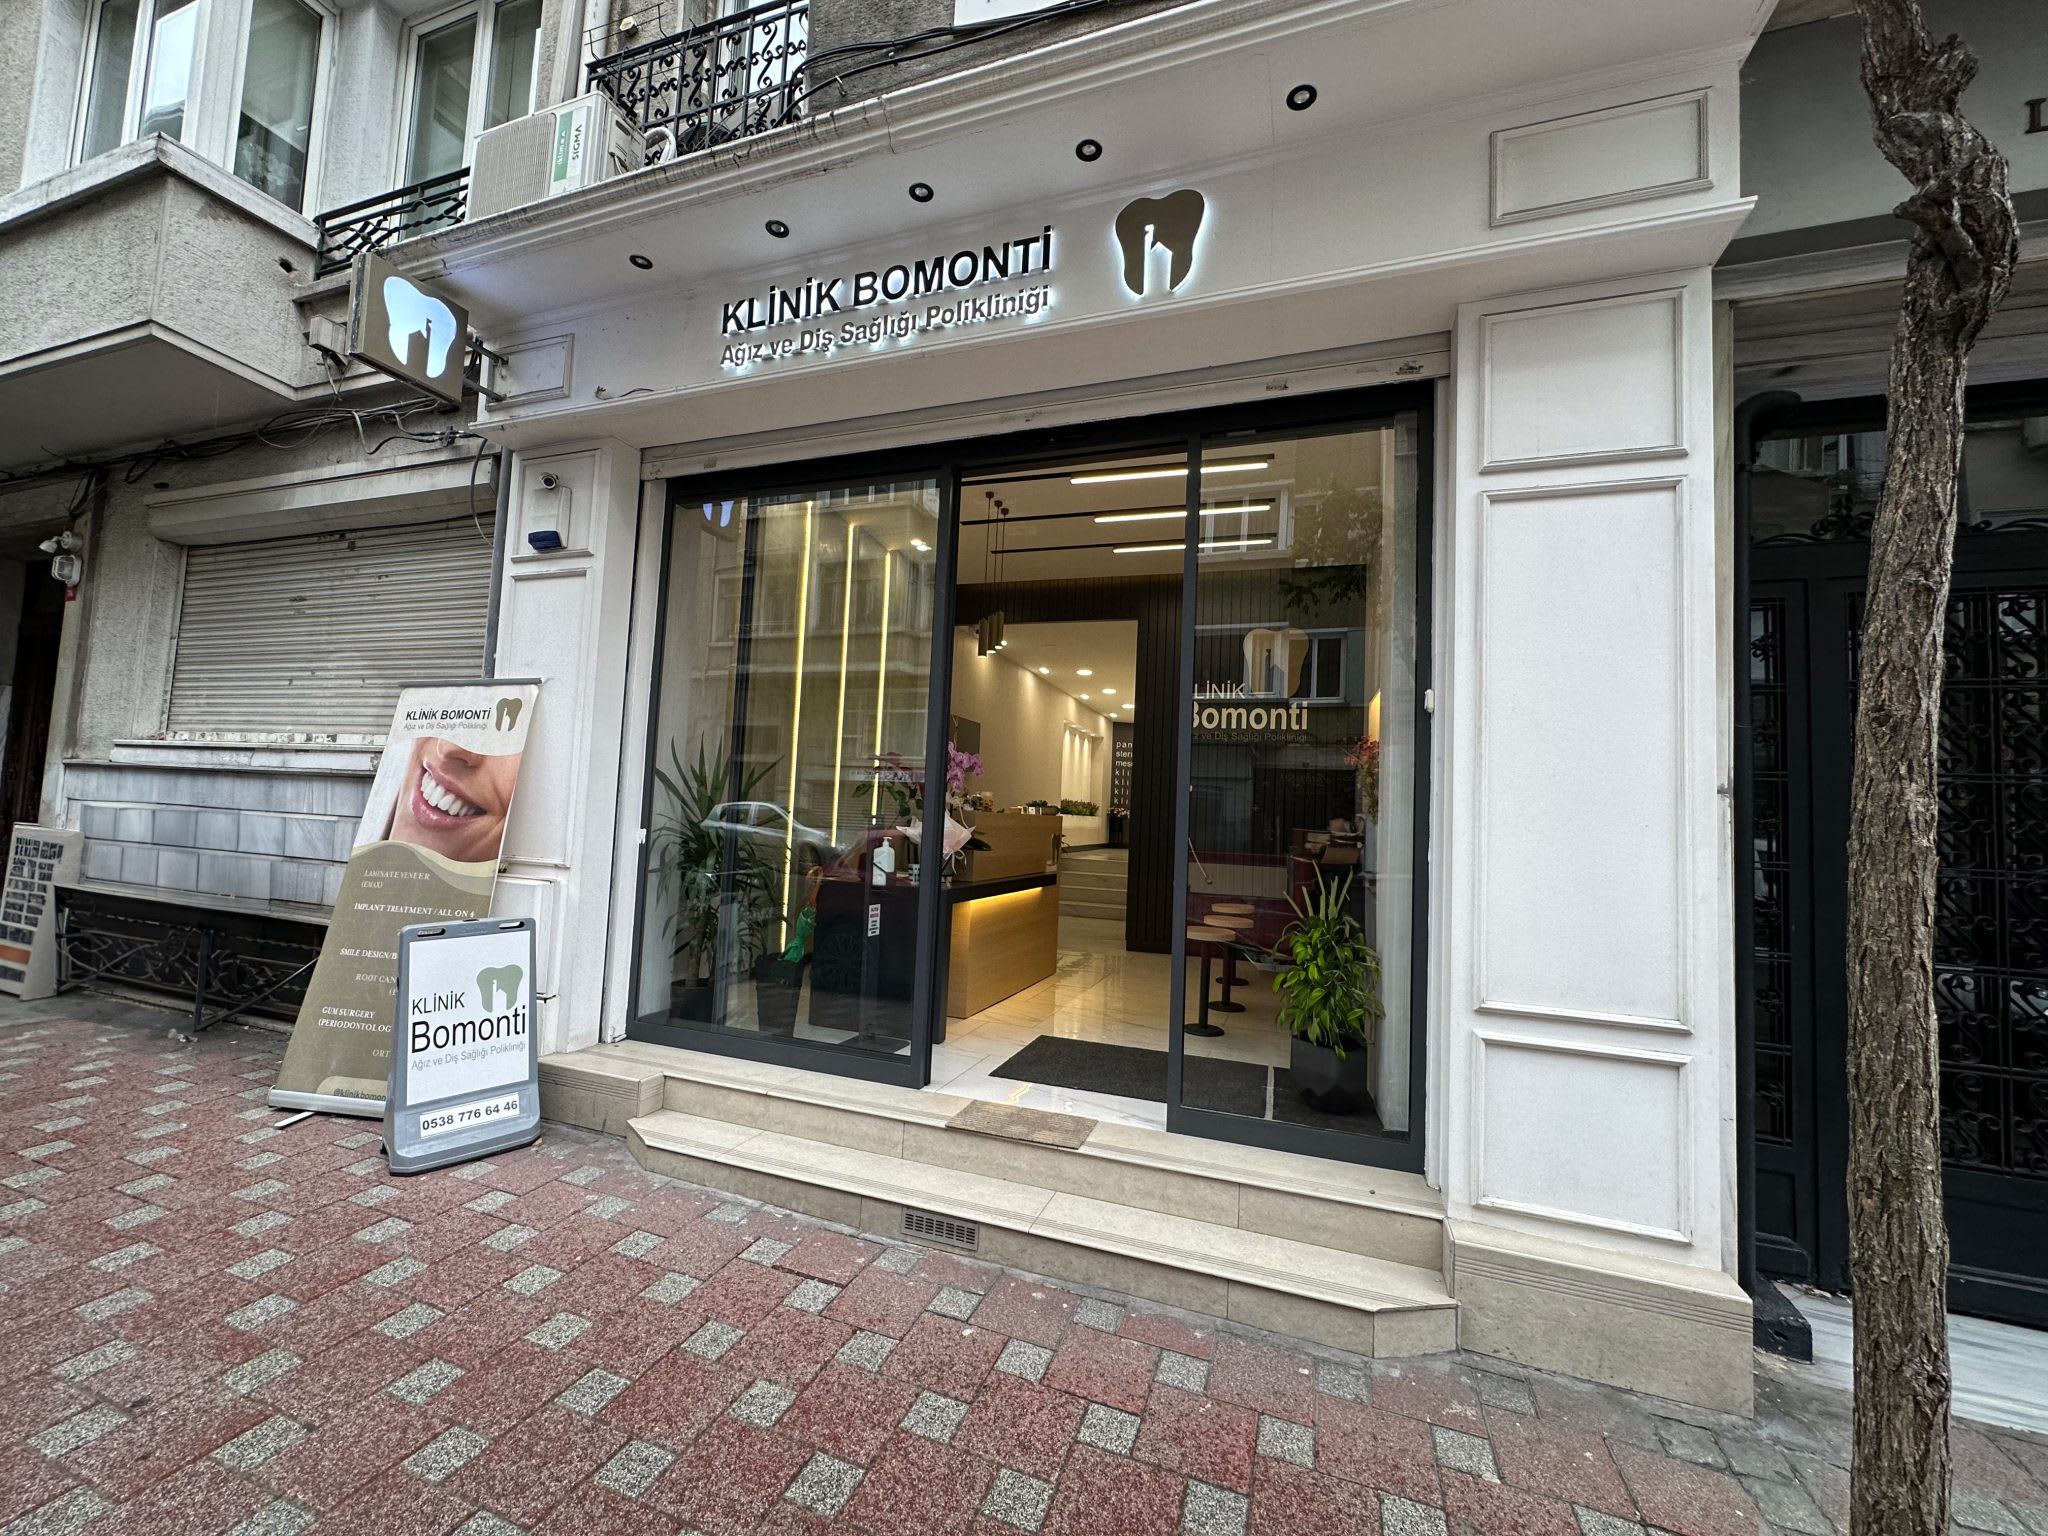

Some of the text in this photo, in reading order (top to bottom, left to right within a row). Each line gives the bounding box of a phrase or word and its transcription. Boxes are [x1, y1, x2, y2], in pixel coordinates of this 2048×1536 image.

[572, 124, 583, 161] SIGMA
[722, 225, 1051, 335] KLİNİK BOMONTİ
[720, 285, 1049, 367] Ağız ve Diş Sağlığı Polikliniği
[1194, 680, 1245, 699] LİNİK
[405, 707, 492, 721] KLİNİK BOMONTİ
[1116, 741, 1133, 749] pan
[364, 870, 431, 880] LAMINATE VENEER
[361, 881, 383, 889] (EMAX)
[354, 902, 386, 912] IMPLANT
[387, 904, 432, 915] TREATMENT
[438, 908, 454, 917] ALL
[454, 909, 469, 918] ON
[470, 910, 475, 918] 4
[340, 947, 398, 959] SMILE DESIGN/B
[355, 973, 397, 984] ROOT CAN
[412, 990, 465, 1016] KLİNİK
[322, 1006, 376, 1019] GUM SURGERY
[318, 1018, 392, 1033] (PERIODONTOLOG
[412, 1004, 526, 1053] Bomonti
[372, 1049, 391, 1058] ORT
[432, 1057, 443, 1066] ve
[333, 1088, 387, 1102] @klinikbomon
[422, 1100, 518, 1131] 0538 776 64 46
